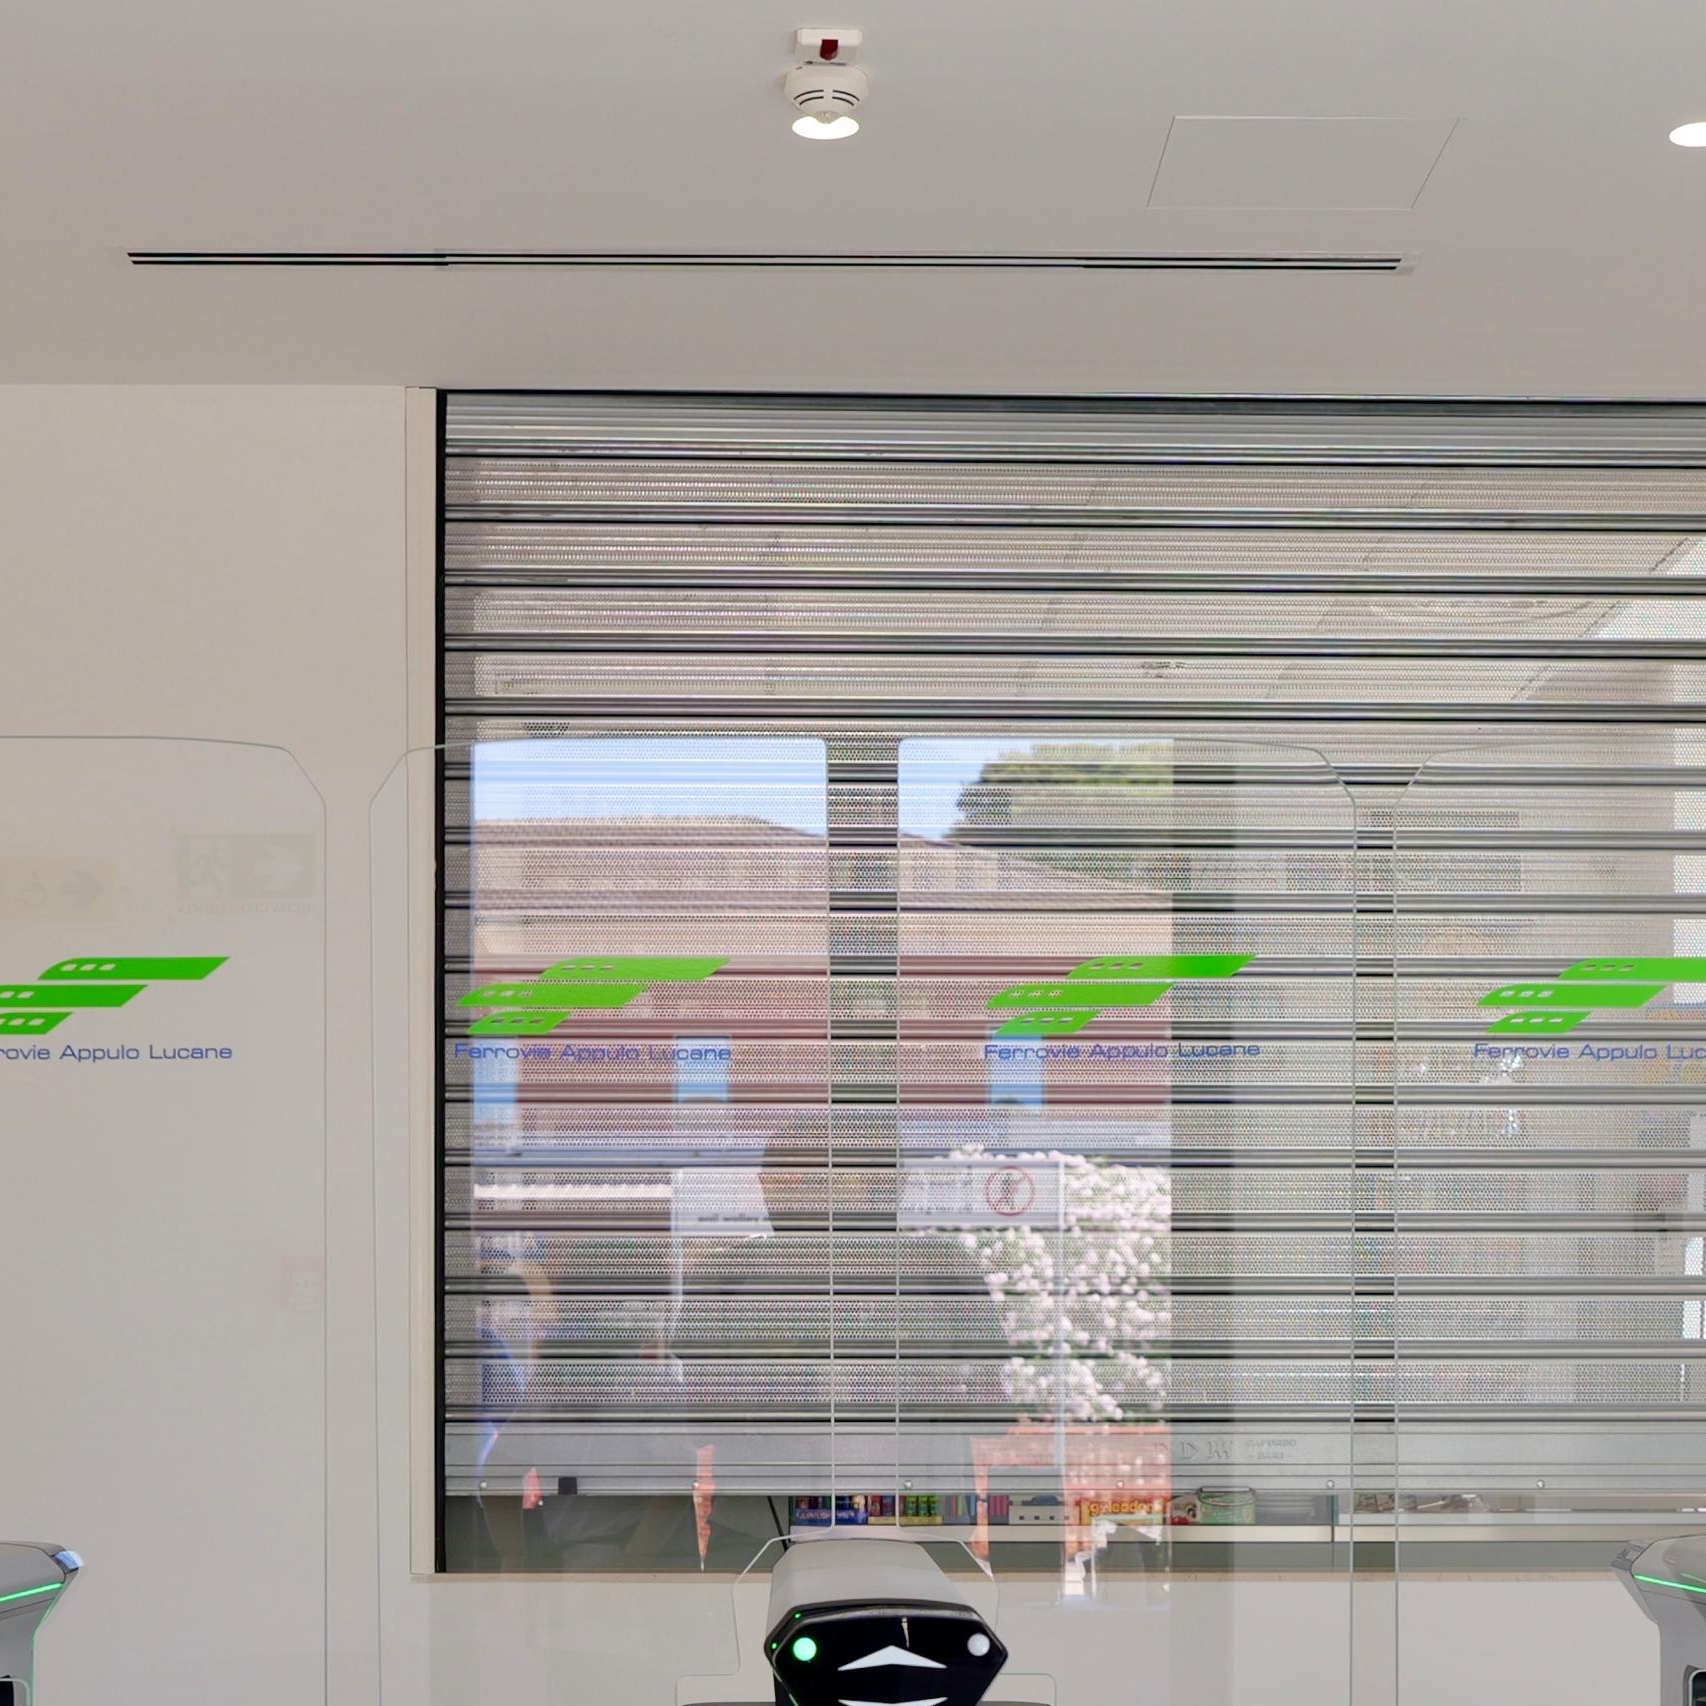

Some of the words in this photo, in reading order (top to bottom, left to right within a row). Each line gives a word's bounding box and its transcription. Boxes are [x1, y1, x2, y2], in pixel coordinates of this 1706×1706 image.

[59, 1044, 140, 1063] Appulo
[149, 1044, 232, 1059] Lucane
[453, 1043, 551, 1059] Ferrovie
[984, 1044, 1081, 1060] Ferrovie
[1089, 1043, 1169, 1061] Appulo
[1178, 1042, 1262, 1058] Lucane
[1473, 1043, 1570, 1059] Ferrovie
[1578, 1043, 1658, 1062] Appulo
